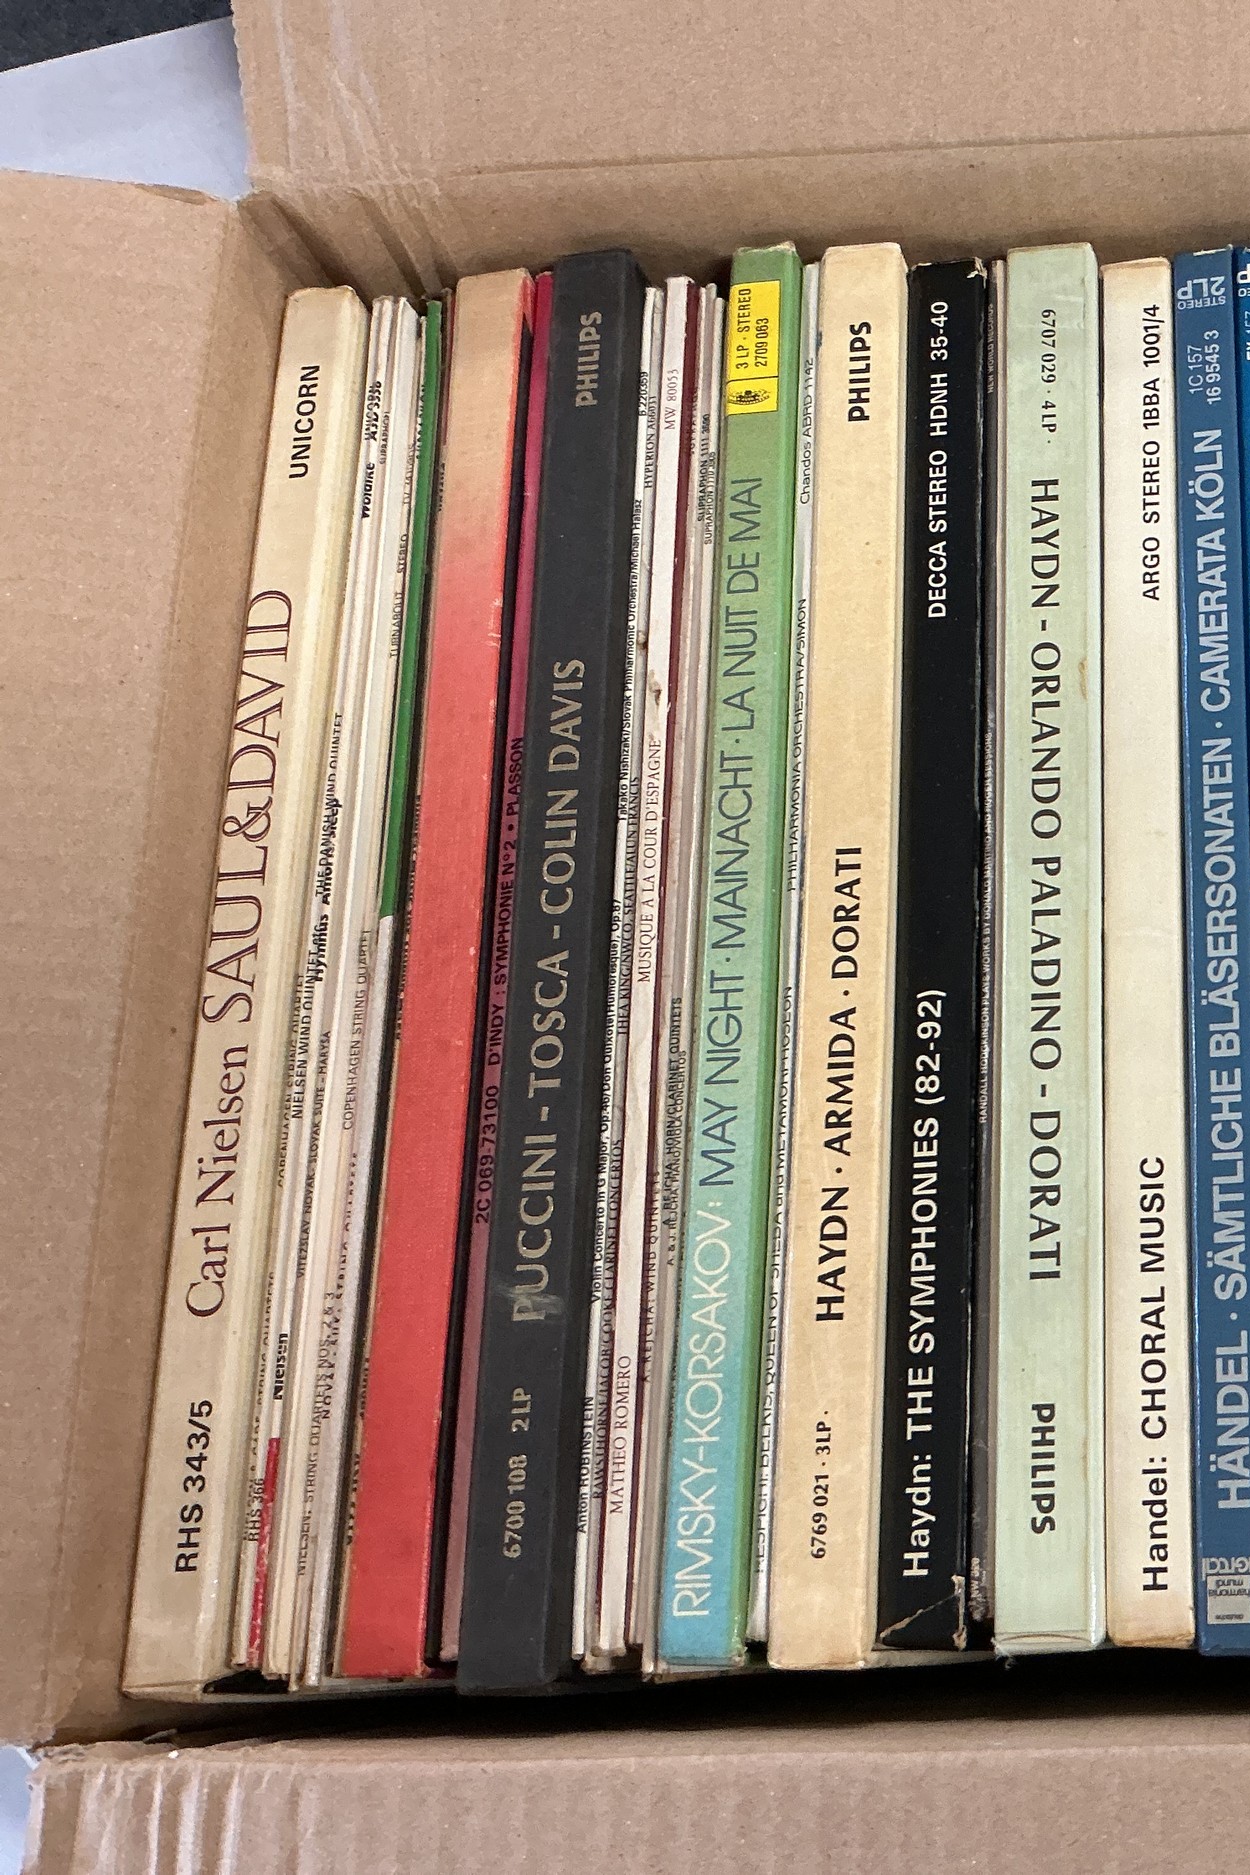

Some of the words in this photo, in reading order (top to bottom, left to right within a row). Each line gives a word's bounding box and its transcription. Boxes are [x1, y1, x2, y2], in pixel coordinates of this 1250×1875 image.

[736, 288, 758, 332] STEREO
[930, 300, 948, 361] 35-40
[1040, 308, 1057, 348] 6707
[1175, 274, 1225, 296] 2LP
[1176, 295, 1225, 306] STEREO
[574, 311, 603, 406] PHILIPS
[736, 344, 755, 357] LP
[736, 360, 755, 368] 3
[847, 321, 872, 421] PHILIPS
[1141, 303, 1164, 367] 1001/4
[287, 364, 320, 478] UNICORN
[664, 406, 676, 430] MW
[930, 372, 948, 436] HDNH
[1141, 377, 1160, 429] 1BBA
[728, 477, 762, 540] MAI
[928, 448, 947, 533] STEREO
[1141, 440, 1161, 523] STEREO
[1188, 429, 1225, 520] KÖLN
[726, 551, 759, 593] DE
[927, 540, 947, 617] DECCA
[1031, 478, 1060, 607] HAYDN
[1141, 536, 1160, 601] ARGO
[722, 604, 758, 676] NUIT
[1195, 528, 1231, 712] CAMERATA
[546, 658, 586, 771] DAVIS
[721, 685, 755, 731] LA
[1030, 641, 1062, 838] ORLANDO
[199, 588, 298, 1024] SAUL&DAVID
[539, 790, 579, 914] COLIN
[642, 827, 657, 868] COUR
[711, 749, 753, 949] MAINACHT
[493, 880, 514, 985] SYMPHONIE
[505, 737, 524, 816] PLASSON
[641, 874, 654, 891] LA
[1193, 737, 1243, 1057] BLÄSERSONATEN
[636, 913, 654, 982] MUSIQUE
[830, 846, 862, 979] DORATI
[1029, 855, 1063, 1069] PALADINO
[527, 949, 571, 1098] TOSCA
[704, 968, 744, 1085] NIGHT
[914, 988, 947, 1105] (82-92)
[192, 1044, 252, 1206] Nielsen
[822, 1006, 856, 1157] ARMIDA
[698, 1096, 738, 1186] MAY
[1201, 1067, 1249, 1301] SÄMTLICHE
[511, 1134, 558, 1321] PUCCINI
[908, 1116, 938, 1354] SYMPHONIES
[1028, 1110, 1062, 1281] DORATI
[1138, 1156, 1166, 1273] MUSIC
[180, 1222, 233, 1318] Carl
[815, 1185, 849, 1322] HAYDN
[614, 1355, 631, 1428] ROMERO
[672, 1199, 732, 1617] RIMSKY-KORSAKOV:
[906, 1366, 934, 1440] THE
[1138, 1286, 1169, 1439] CHORAL
[180, 1398, 215, 1492] 343/5
[506, 1454, 529, 1494] 108
[609, 1436, 627, 1513] MATHEO
[813, 1473, 829, 1506] 021
[1030, 1402, 1056, 1533] PHILIPS
[172, 1502, 204, 1572] RHS
[502, 1500, 526, 1558] 6700
[810, 1512, 828, 1558] 6769
[902, 1453, 936, 1577] Haydn:
[1140, 1455, 1170, 1591] Handel:
